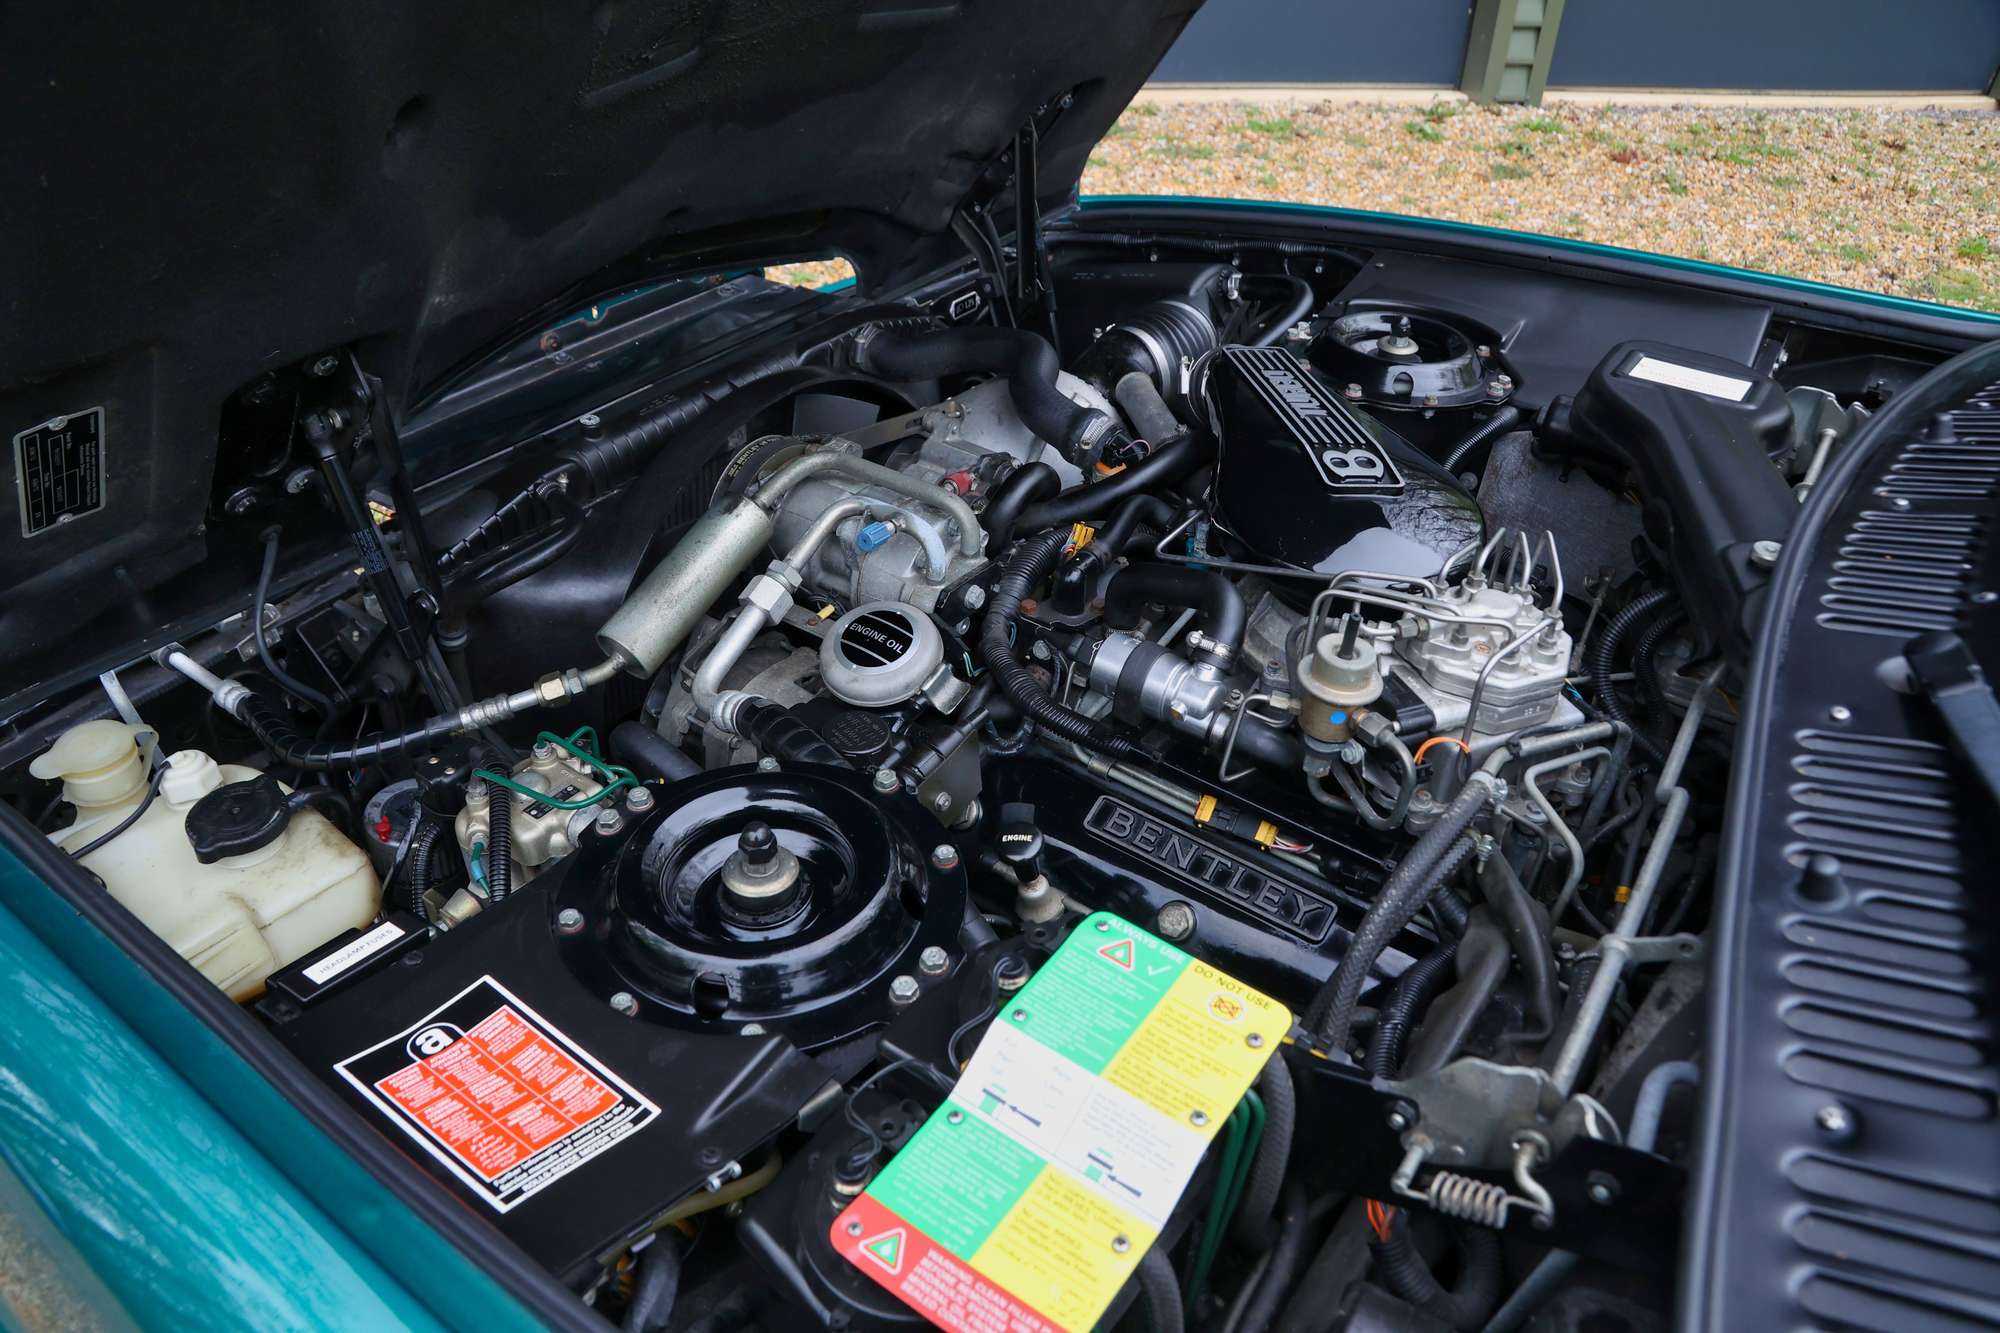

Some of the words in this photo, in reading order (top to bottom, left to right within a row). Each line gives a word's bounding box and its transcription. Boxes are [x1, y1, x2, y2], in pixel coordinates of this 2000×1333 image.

[850, 622, 887, 644] ENGINE
[886, 637, 904, 654] OIL
[1002, 834, 1033, 843] ENGINE
[1102, 805, 1324, 928] BENTLEY
[1109, 917, 1158, 950] ALWAYS
[1158, 944, 1185, 965] USE
[1194, 965, 1214, 979] DO
[1218, 976, 1244, 995] NOT
[1246, 992, 1271, 1010] USE
